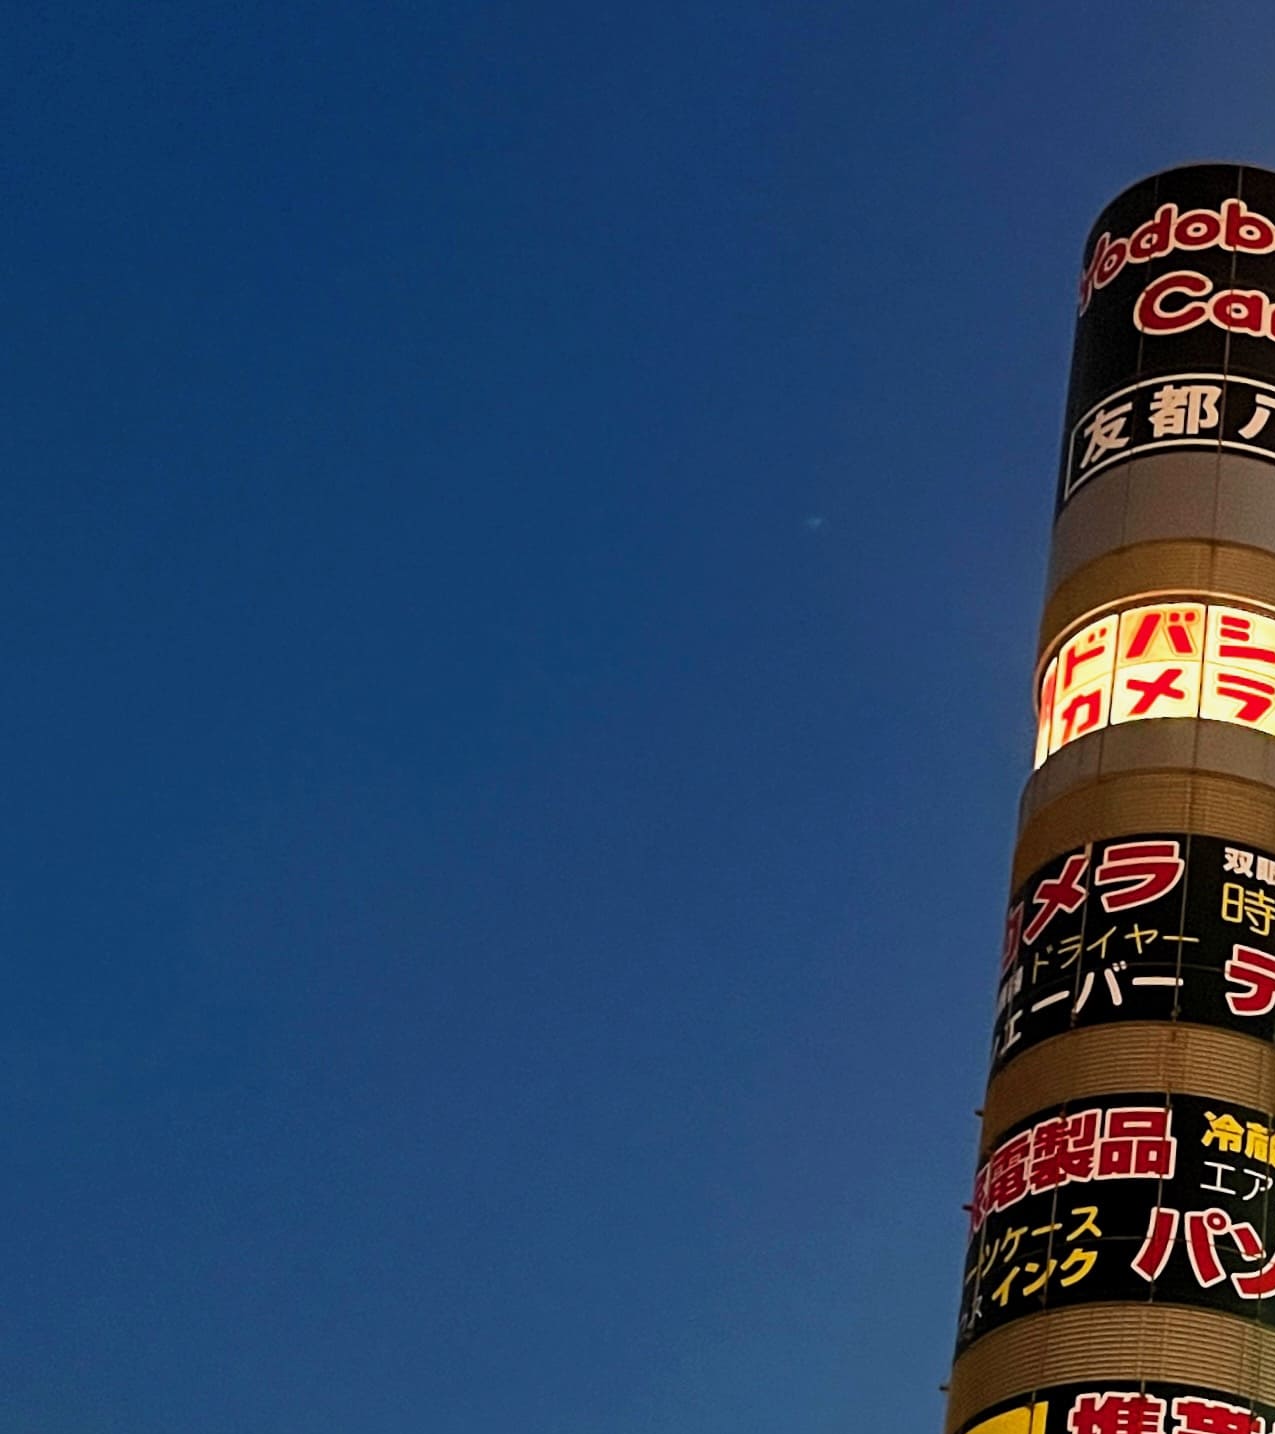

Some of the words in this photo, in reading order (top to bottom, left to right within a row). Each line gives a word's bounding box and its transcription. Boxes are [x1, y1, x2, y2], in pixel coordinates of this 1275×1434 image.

[1031, 923, 1201, 986] ドライヤー
[991, 1247, 1099, 1308] インク
